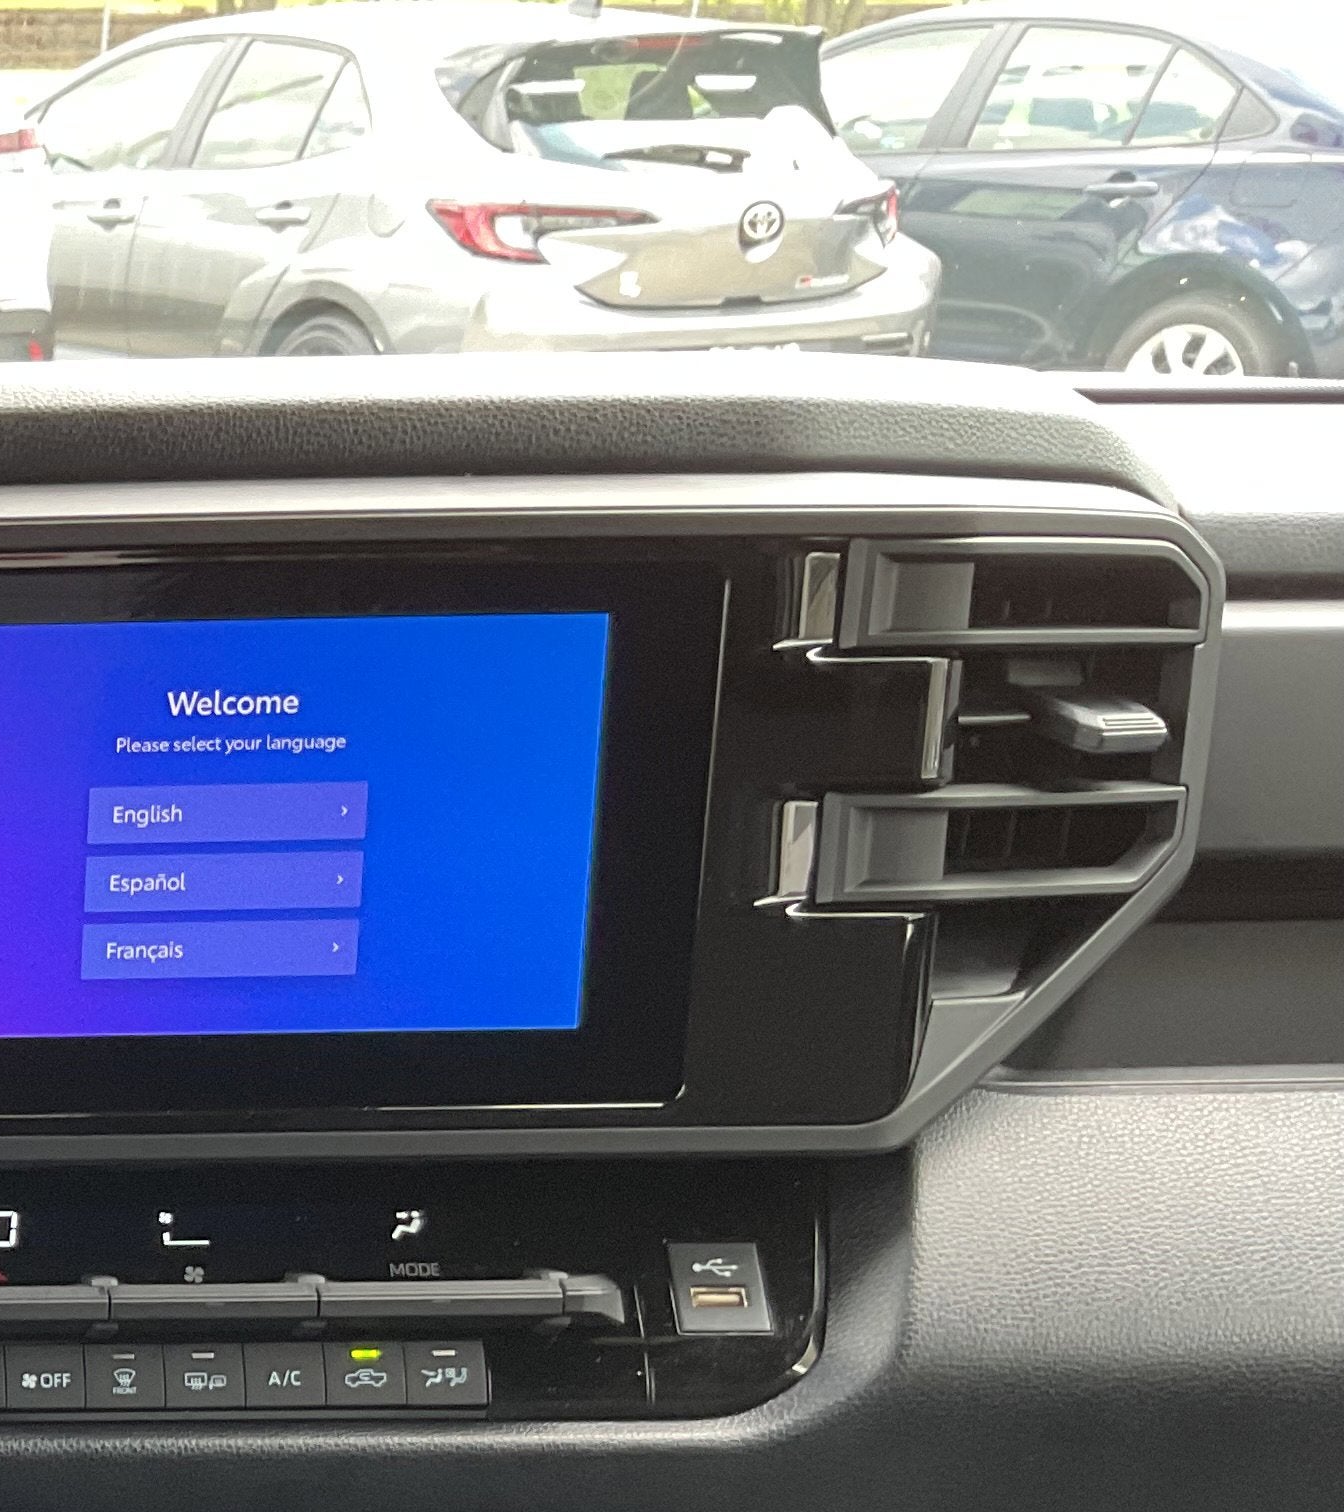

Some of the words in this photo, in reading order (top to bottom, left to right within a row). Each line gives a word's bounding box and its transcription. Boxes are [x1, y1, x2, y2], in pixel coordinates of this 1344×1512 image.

[167, 690, 299, 716] Welcome
[116, 737, 169, 753] Please
[173, 736, 221, 752] select
[225, 737, 262, 755] your
[266, 734, 347, 753] language
[112, 804, 183, 828] English
[109, 871, 186, 895] Español
[105, 937, 184, 963] Français
[389, 1262, 441, 1278] MODE
[39, 1372, 71, 1389] OFF
[268, 1369, 302, 1387] A/C
